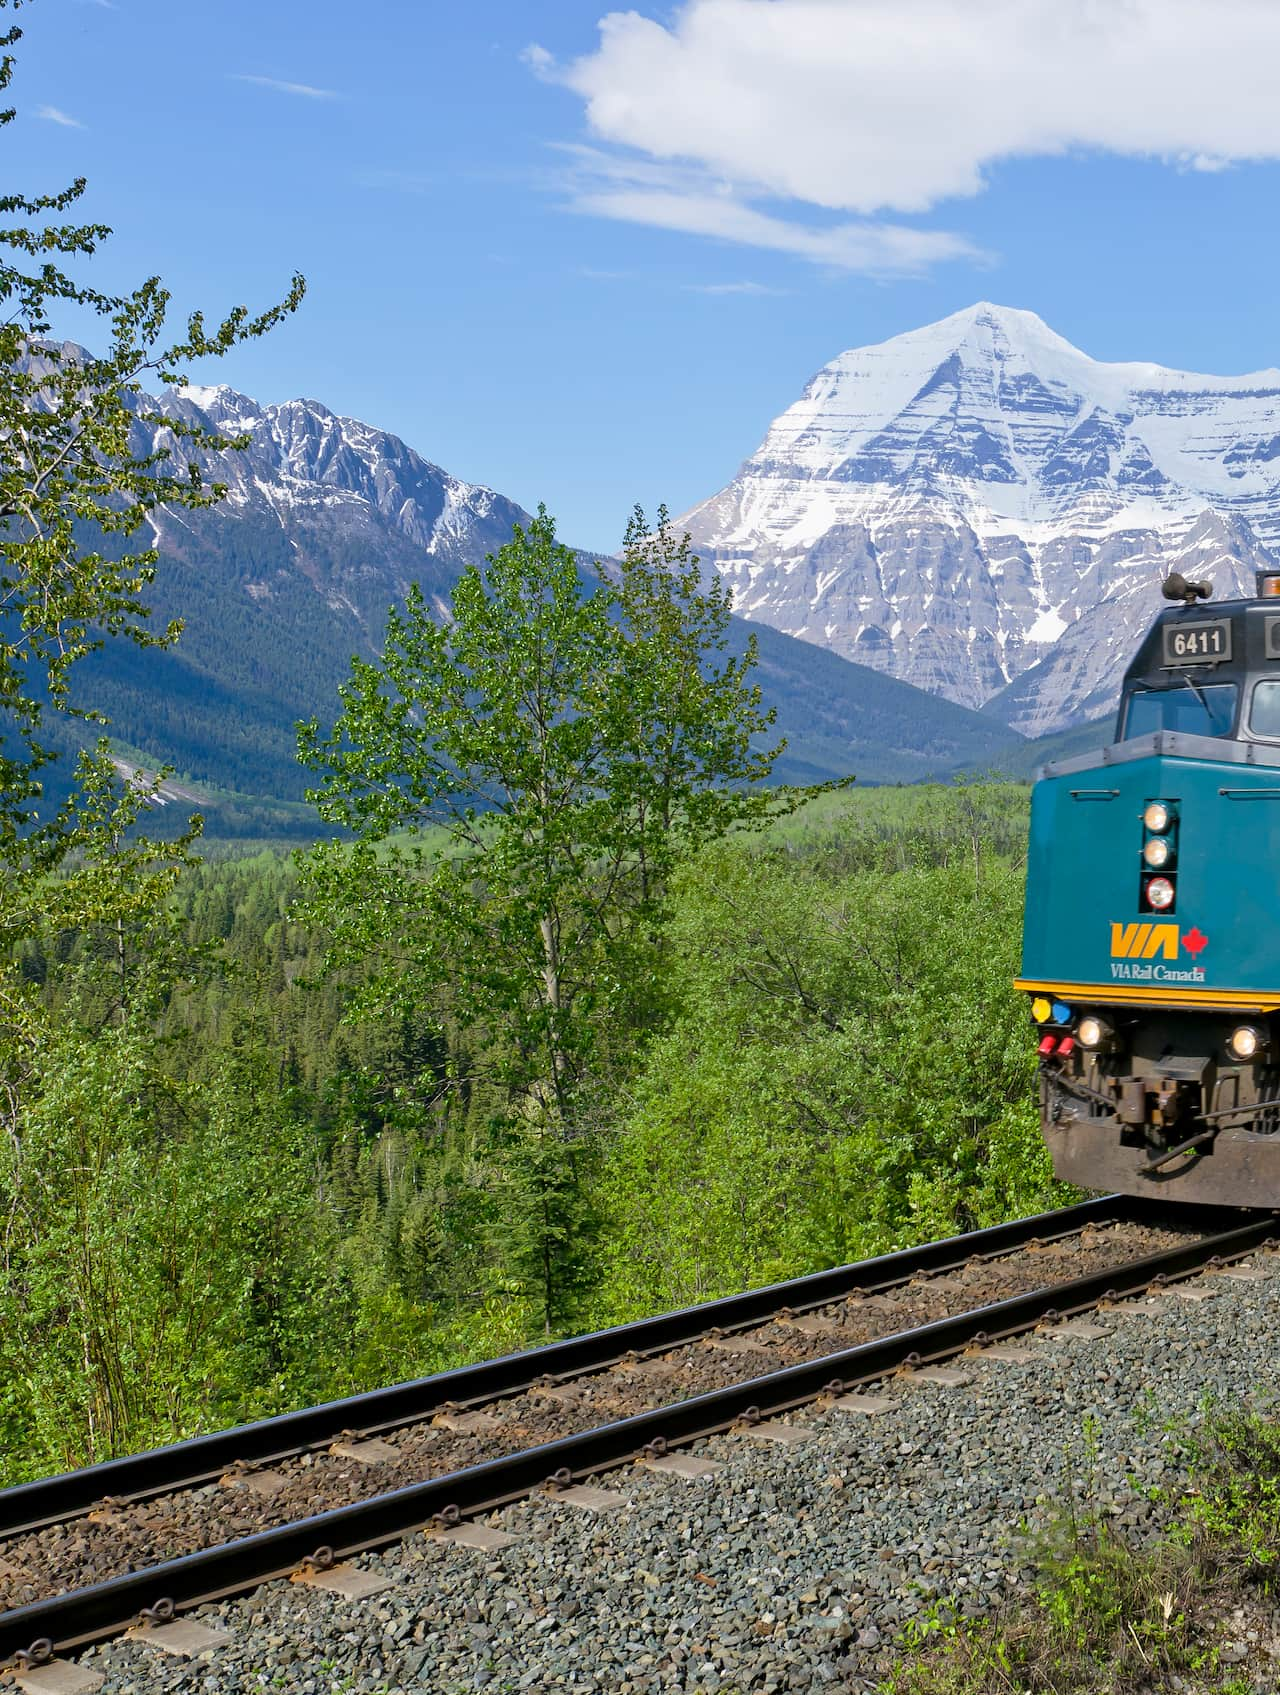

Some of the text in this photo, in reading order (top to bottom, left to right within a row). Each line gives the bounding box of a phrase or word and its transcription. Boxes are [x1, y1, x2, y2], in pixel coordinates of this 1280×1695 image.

[1174, 630, 1220, 655] 6411
[1111, 923, 1179, 959] VIA
[1110, 963, 1205, 982] VIA Rail Canada
